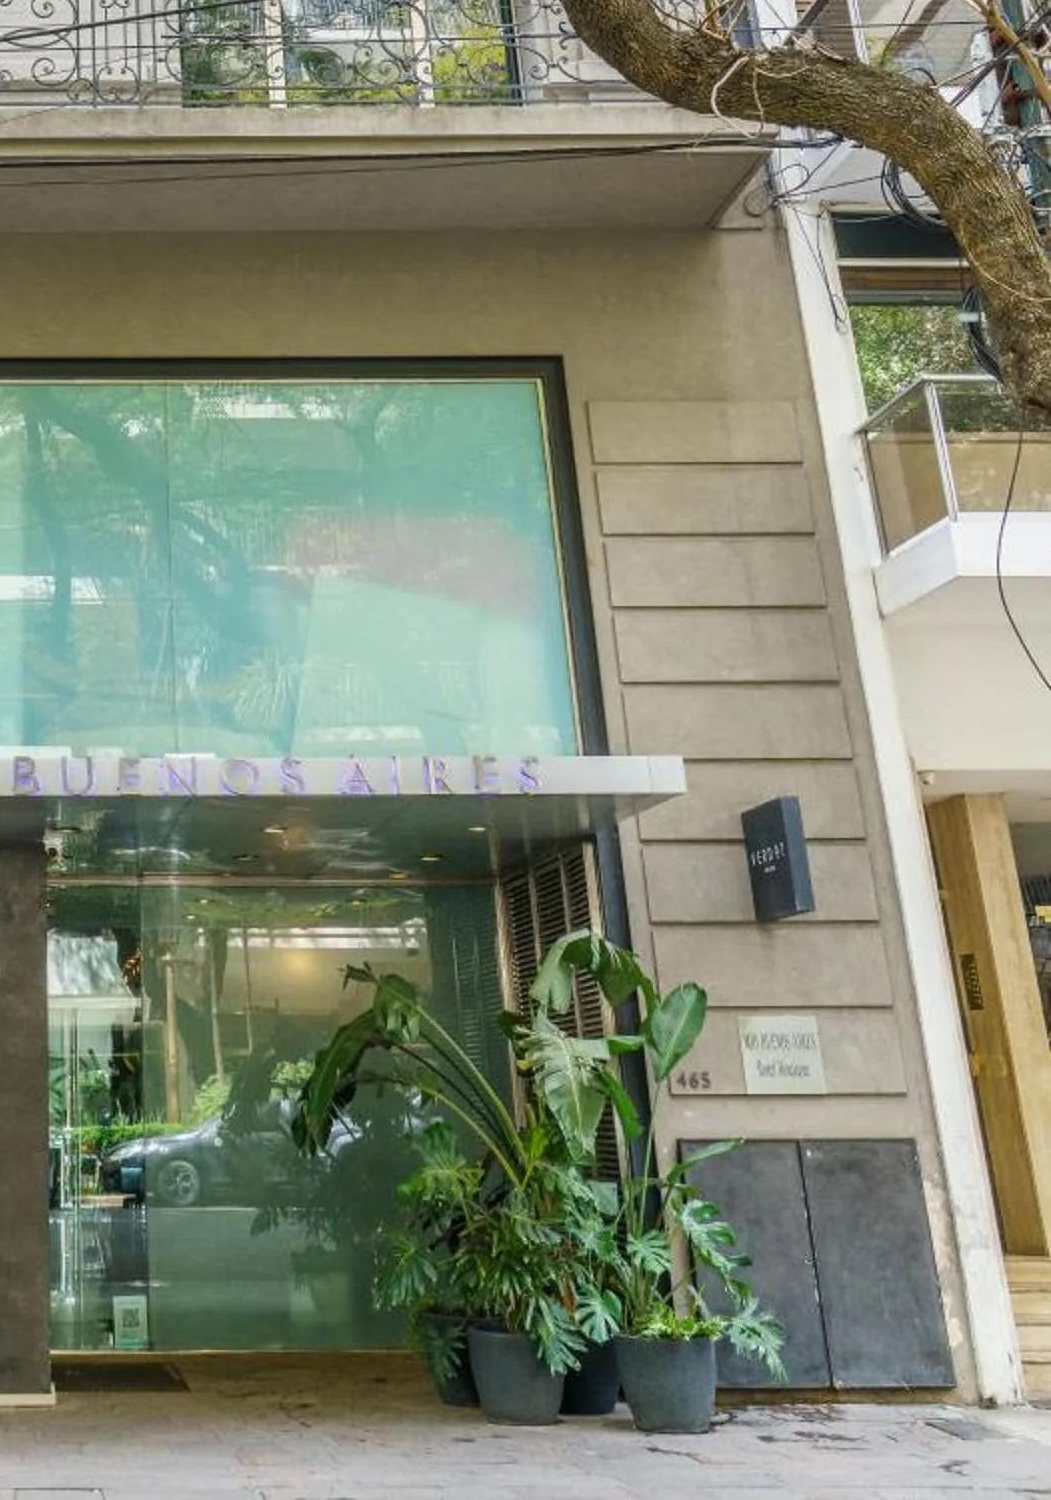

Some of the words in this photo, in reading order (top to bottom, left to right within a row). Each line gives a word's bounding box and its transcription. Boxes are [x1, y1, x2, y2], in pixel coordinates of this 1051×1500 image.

[13, 755, 305, 797] BUENOS
[342, 754, 543, 797] AIRES
[676, 1071, 711, 1089] 465
